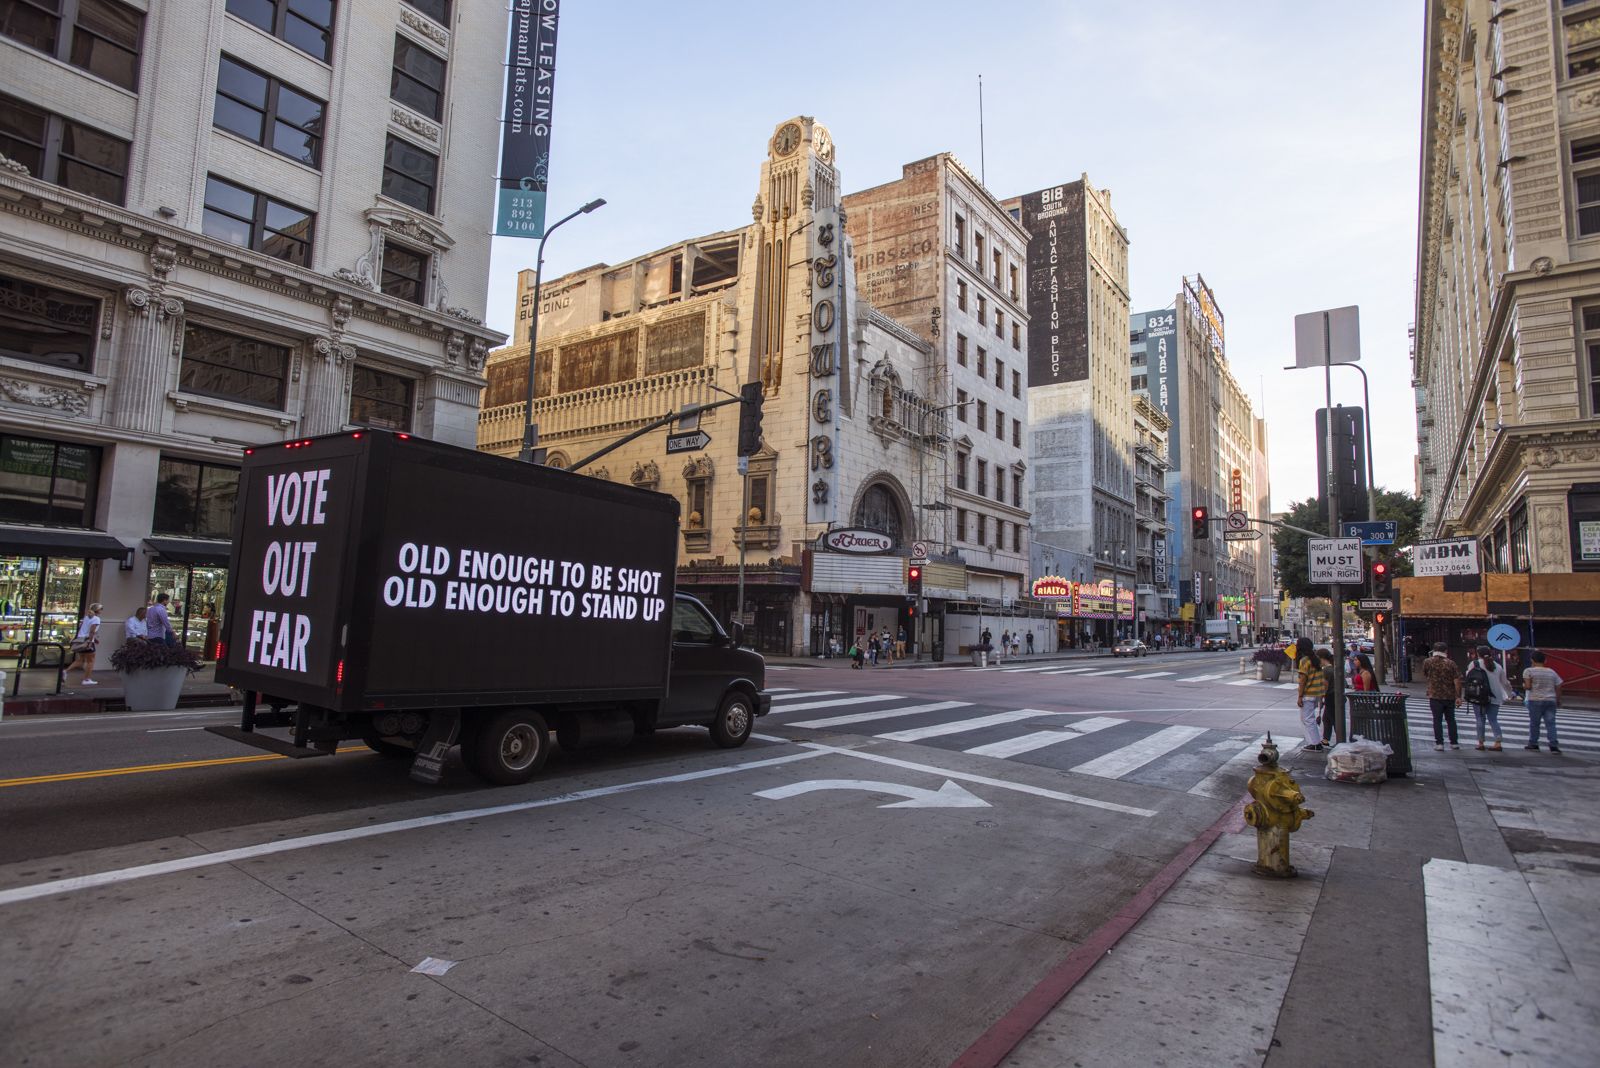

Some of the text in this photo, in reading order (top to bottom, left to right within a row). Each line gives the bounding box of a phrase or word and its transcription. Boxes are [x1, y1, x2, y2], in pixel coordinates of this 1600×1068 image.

[534, 41, 554, 137] LEASING
[1041, 186, 1064, 204] 818
[512, 198, 533, 208] 213
[1042, 201, 1063, 212] SOUTH
[511, 209, 532, 219] 892
[1037, 206, 1068, 221] BROADWAY
[507, 220, 535, 231] 9100
[1049, 219, 1058, 263] ANJAC
[866, 287, 882, 296] AND
[1050, 266, 1059, 329] FASHION
[520, 297, 570, 321] BULDING
[1148, 314, 1175, 328] 834
[810, 254, 837, 472] TOWER
[1158, 338, 1167, 373] ANJAC
[669, 435, 700, 450] ONE WAY
[267, 468, 331, 526] VOTE
[1385, 522, 1394, 530] St
[1370, 532, 1385, 540] 300
[1438, 536, 1469, 544] CONTRACTORS
[1311, 543, 1359, 551] RIGHT LANE
[1420, 544, 1470, 560] MDM
[1156, 541, 1164, 582] LYNNS
[1316, 556, 1354, 565] MUST
[262, 541, 317, 597] OUT
[399, 542, 662, 595] OLD ENOUGH TO BE SHOT
[1312, 570, 1359, 578] TURN RIGHT
[1420, 564, 1471, 573] 213.327.0646
[1037, 586, 1066, 595] RIALTO
[383, 575, 665, 622] OLD ENOUGH TO STAND UP
[247, 609, 311, 673] FEAR
[414, 758, 442, 772] SUPREME
